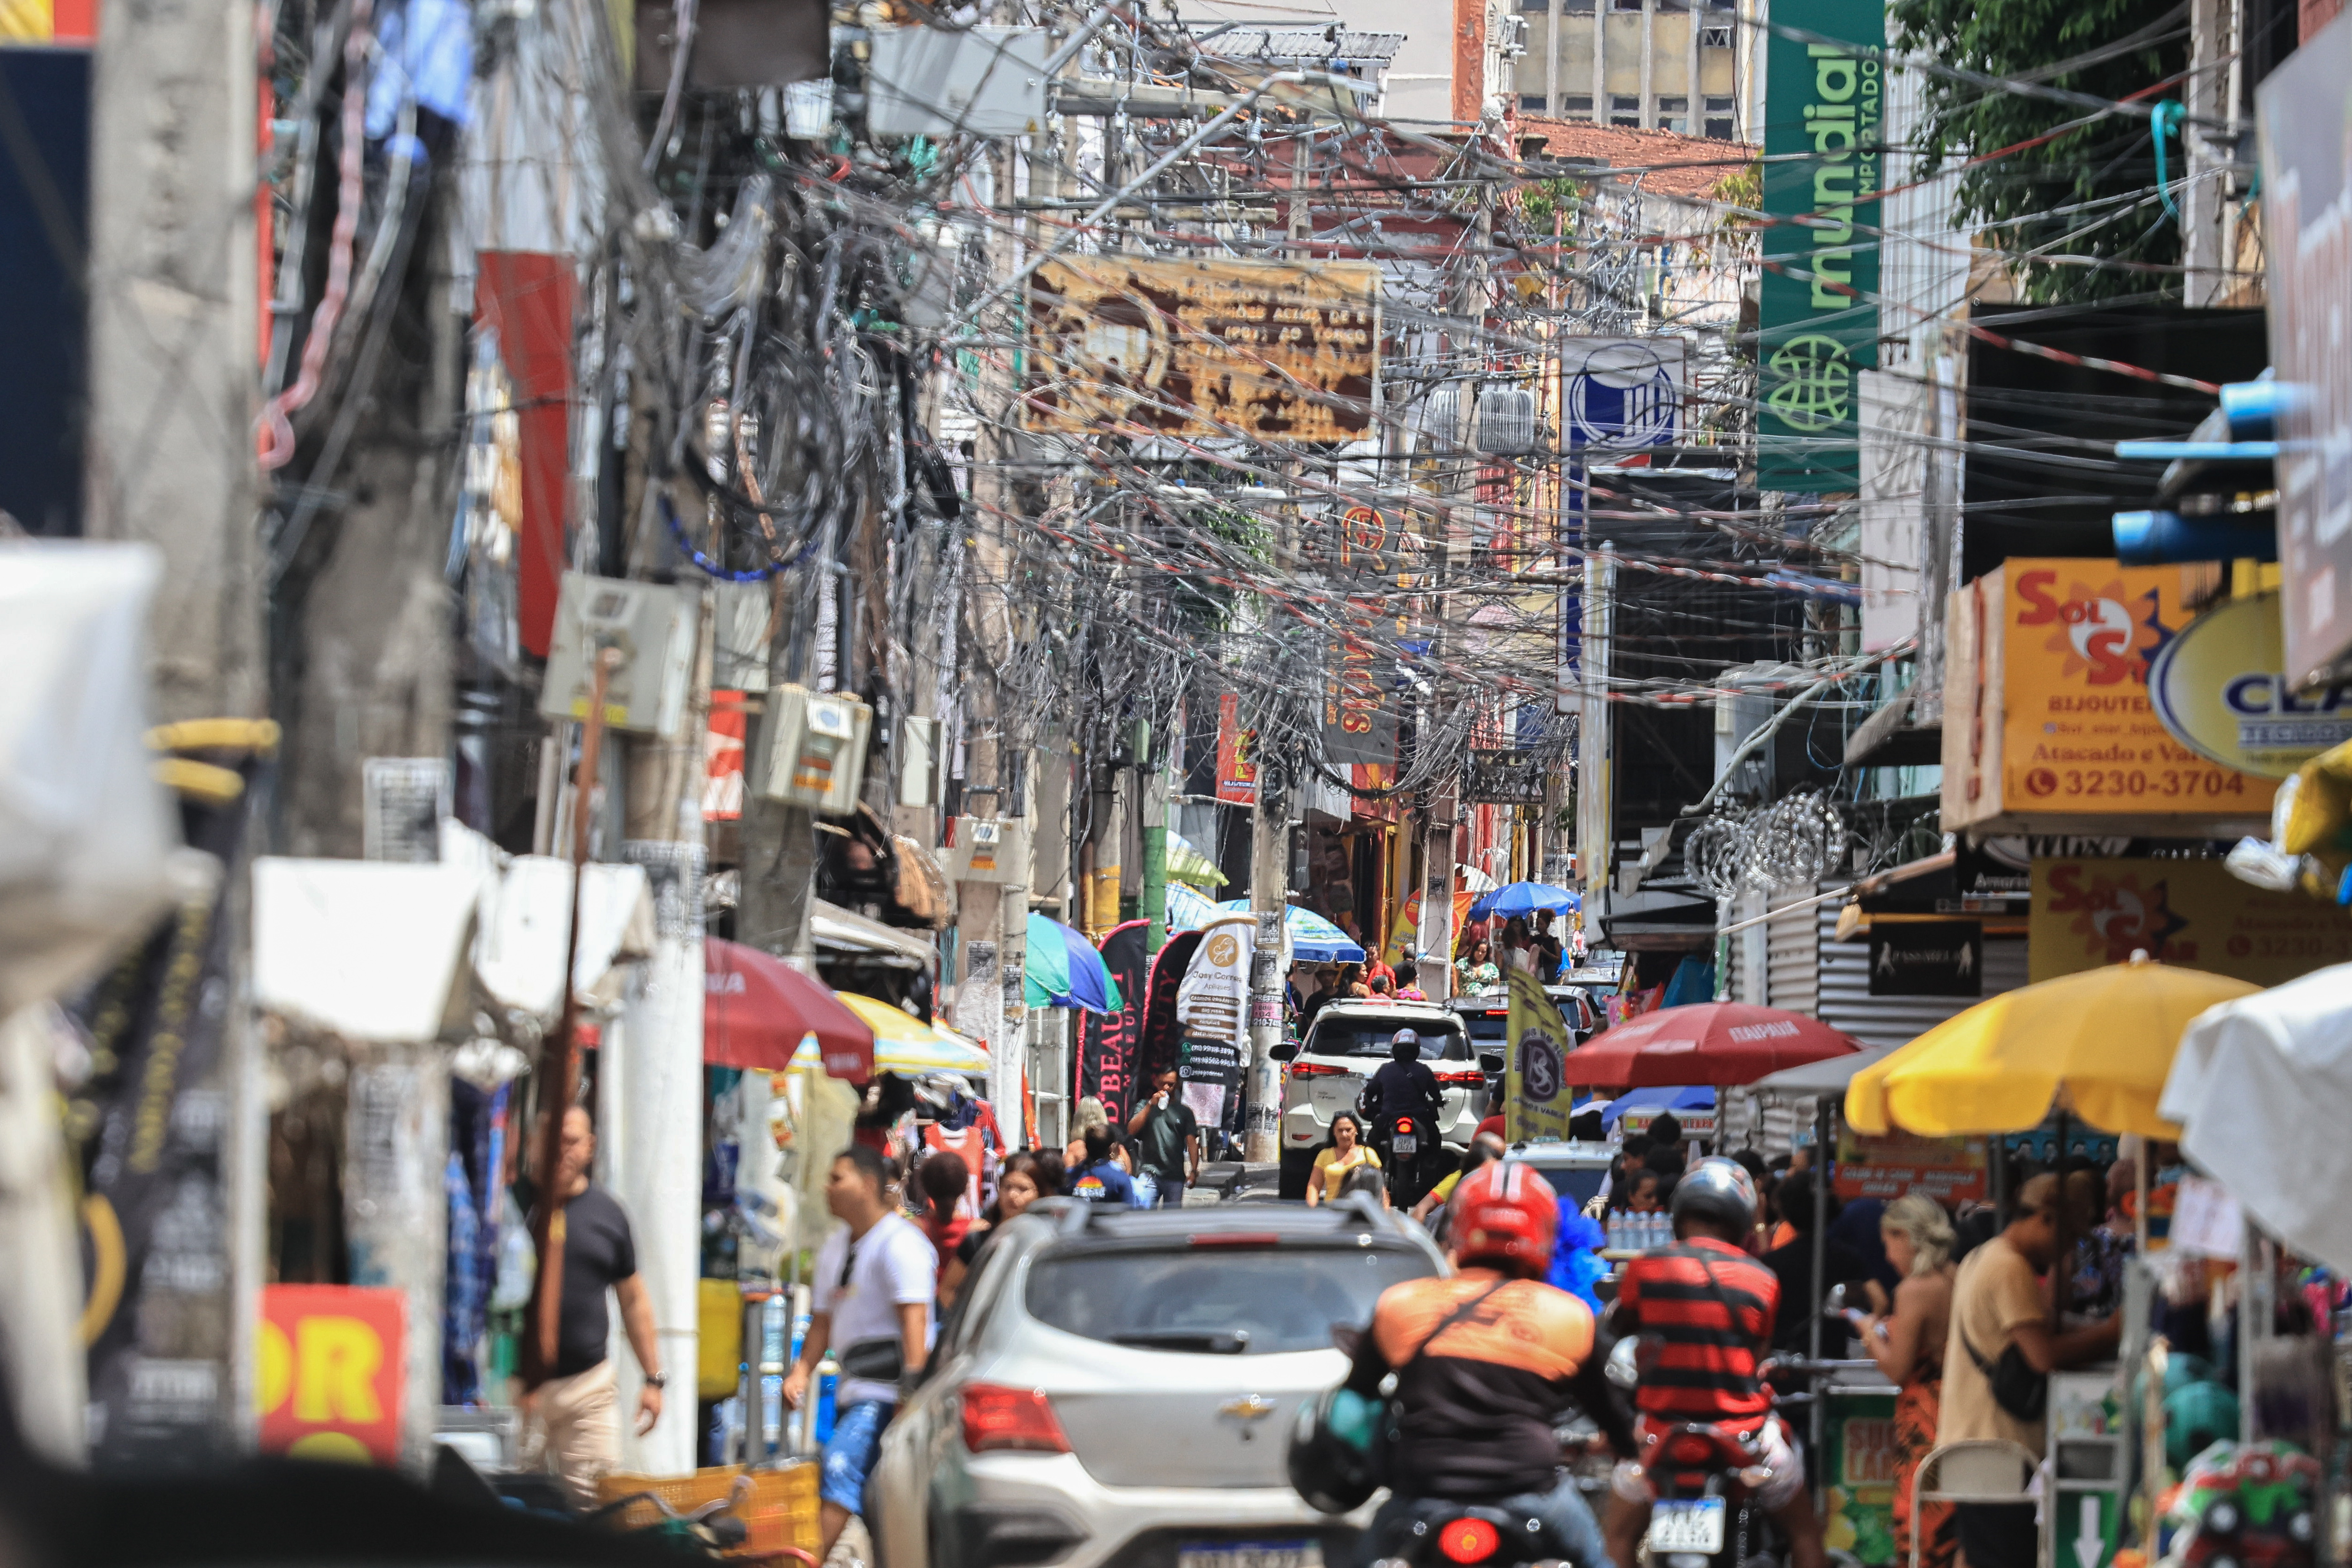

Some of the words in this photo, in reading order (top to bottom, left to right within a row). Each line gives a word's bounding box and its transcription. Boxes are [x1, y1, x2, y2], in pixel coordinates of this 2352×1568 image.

[1859, 44, 1878, 198] MPORTADOS
[1803, 43, 1857, 310] mundial
[2032, 742, 2136, 764] Atacado
[2140, 749, 2154, 764] e
[2064, 769, 2245, 797] 3230-3704
